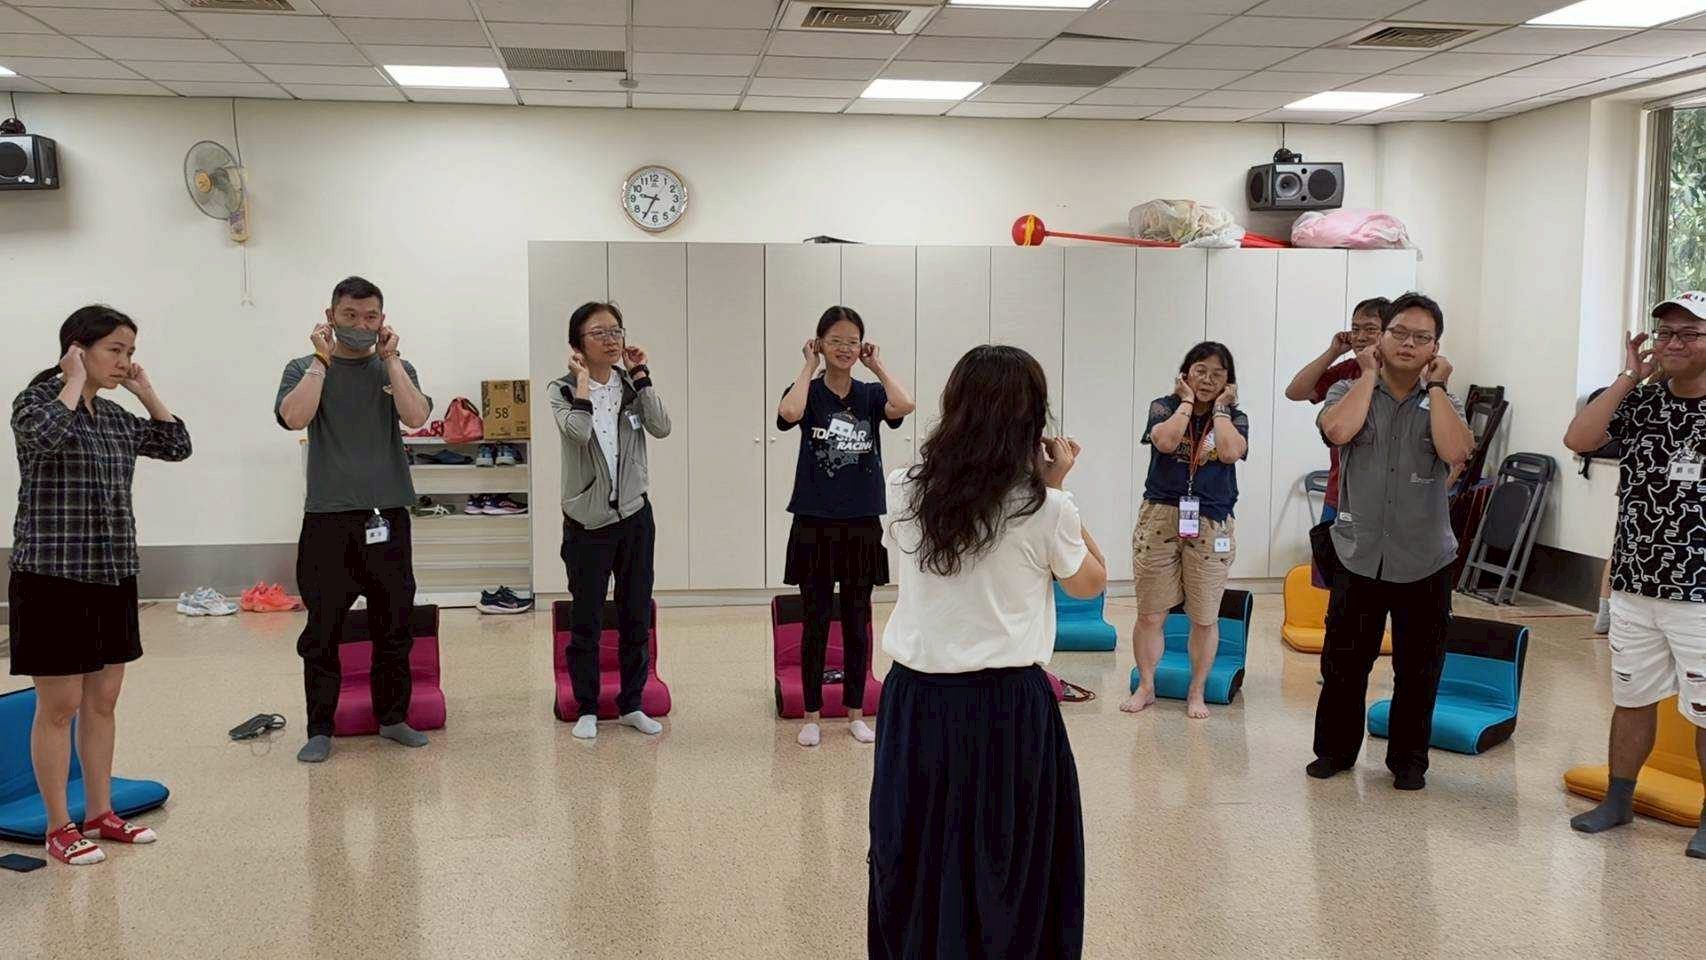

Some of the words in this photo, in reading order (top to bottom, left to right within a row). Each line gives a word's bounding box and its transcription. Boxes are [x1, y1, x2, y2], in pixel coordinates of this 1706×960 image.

[641, 177, 648, 186] 11
[650, 174, 660, 182] 12
[633, 184, 642, 193] 10
[669, 184, 676, 193] 2
[630, 194, 637, 203] 9
[673, 194, 679, 204] 3
[634, 204, 640, 213] 8
[651, 214, 659, 223] 6
[662, 211, 669, 220] 5
[494, 407, 509, 419] 58
